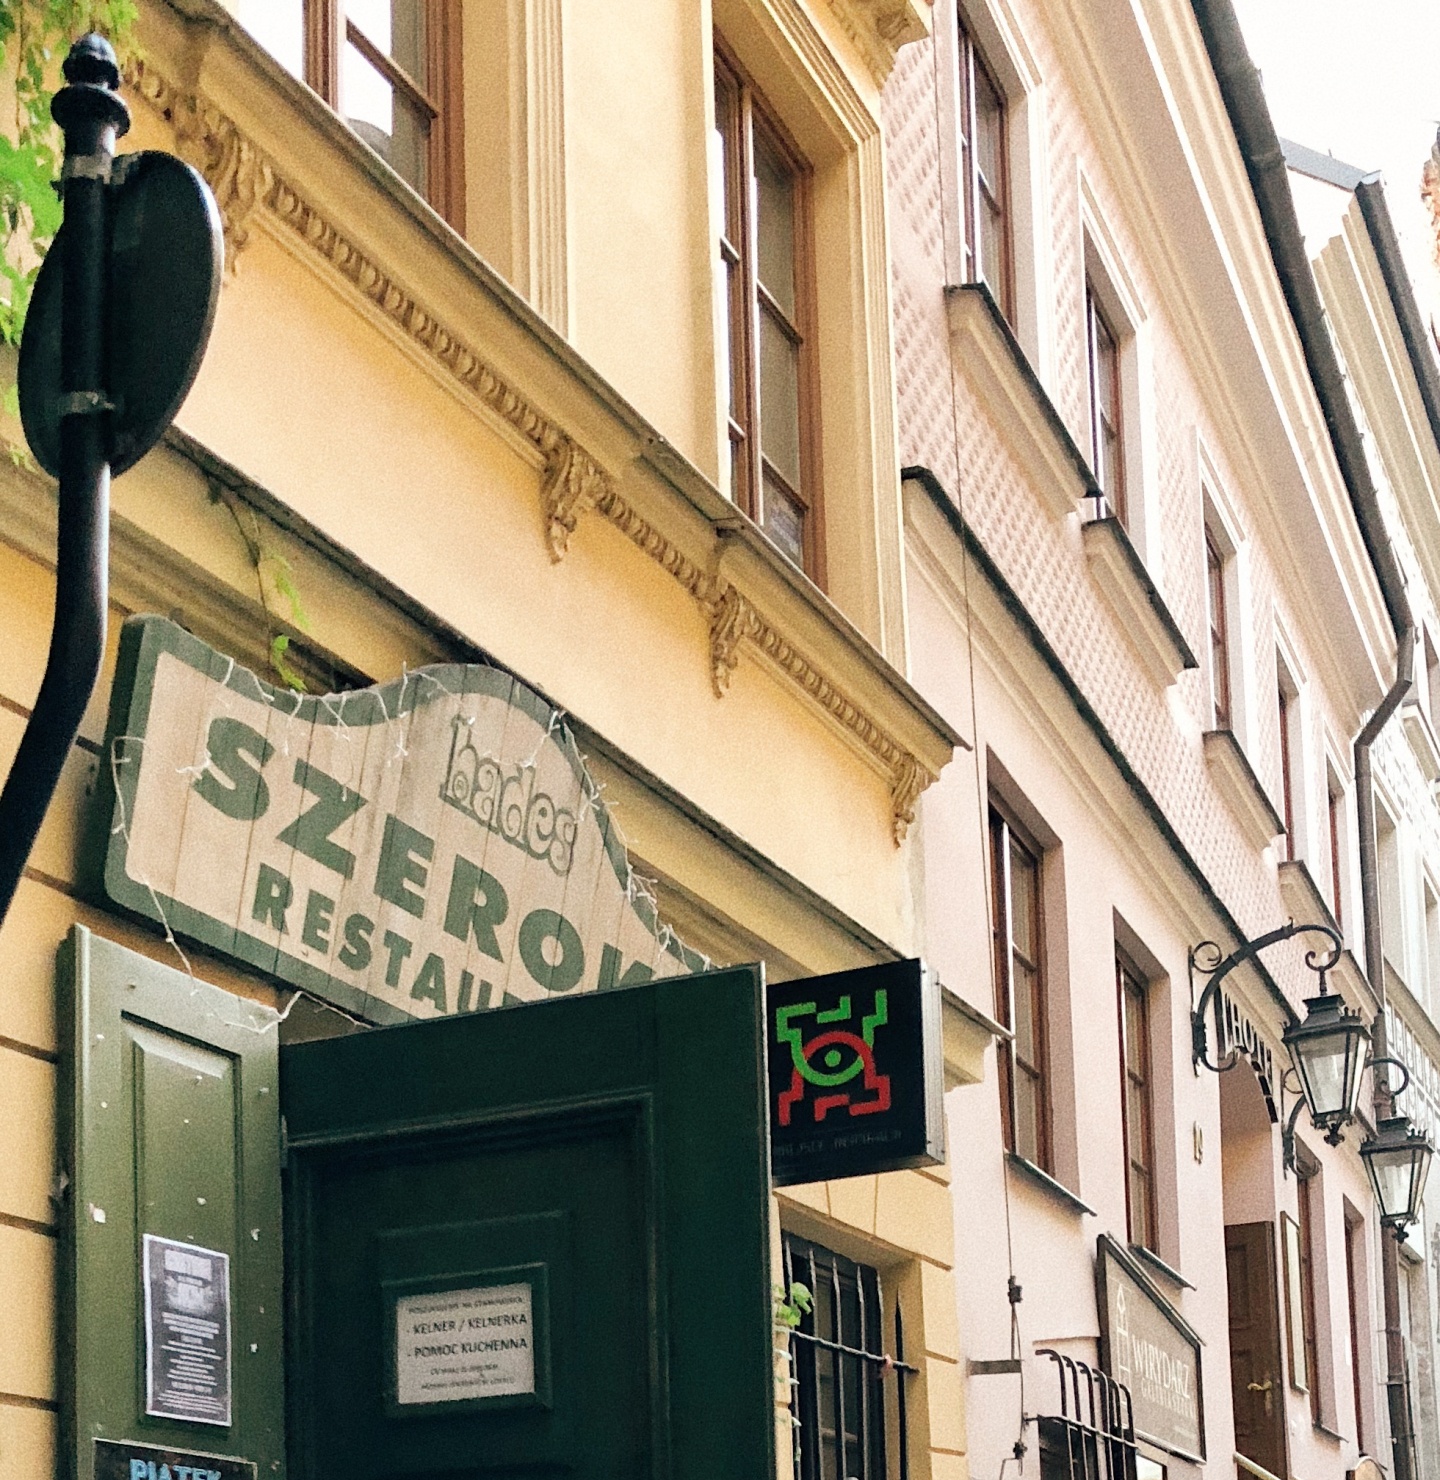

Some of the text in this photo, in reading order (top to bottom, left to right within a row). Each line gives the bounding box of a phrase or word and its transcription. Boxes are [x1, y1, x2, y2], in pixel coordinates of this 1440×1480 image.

[251, 862, 525, 1014] RESTAU
[413, 1320, 456, 1335] KELNER
[468, 1313, 528, 1330] KELNERKA
[414, 1344, 459, 1359] POMOC
[461, 1337, 528, 1354] KUCHENNA
[1132, 1333, 1191, 1399] WIRYDARZ
